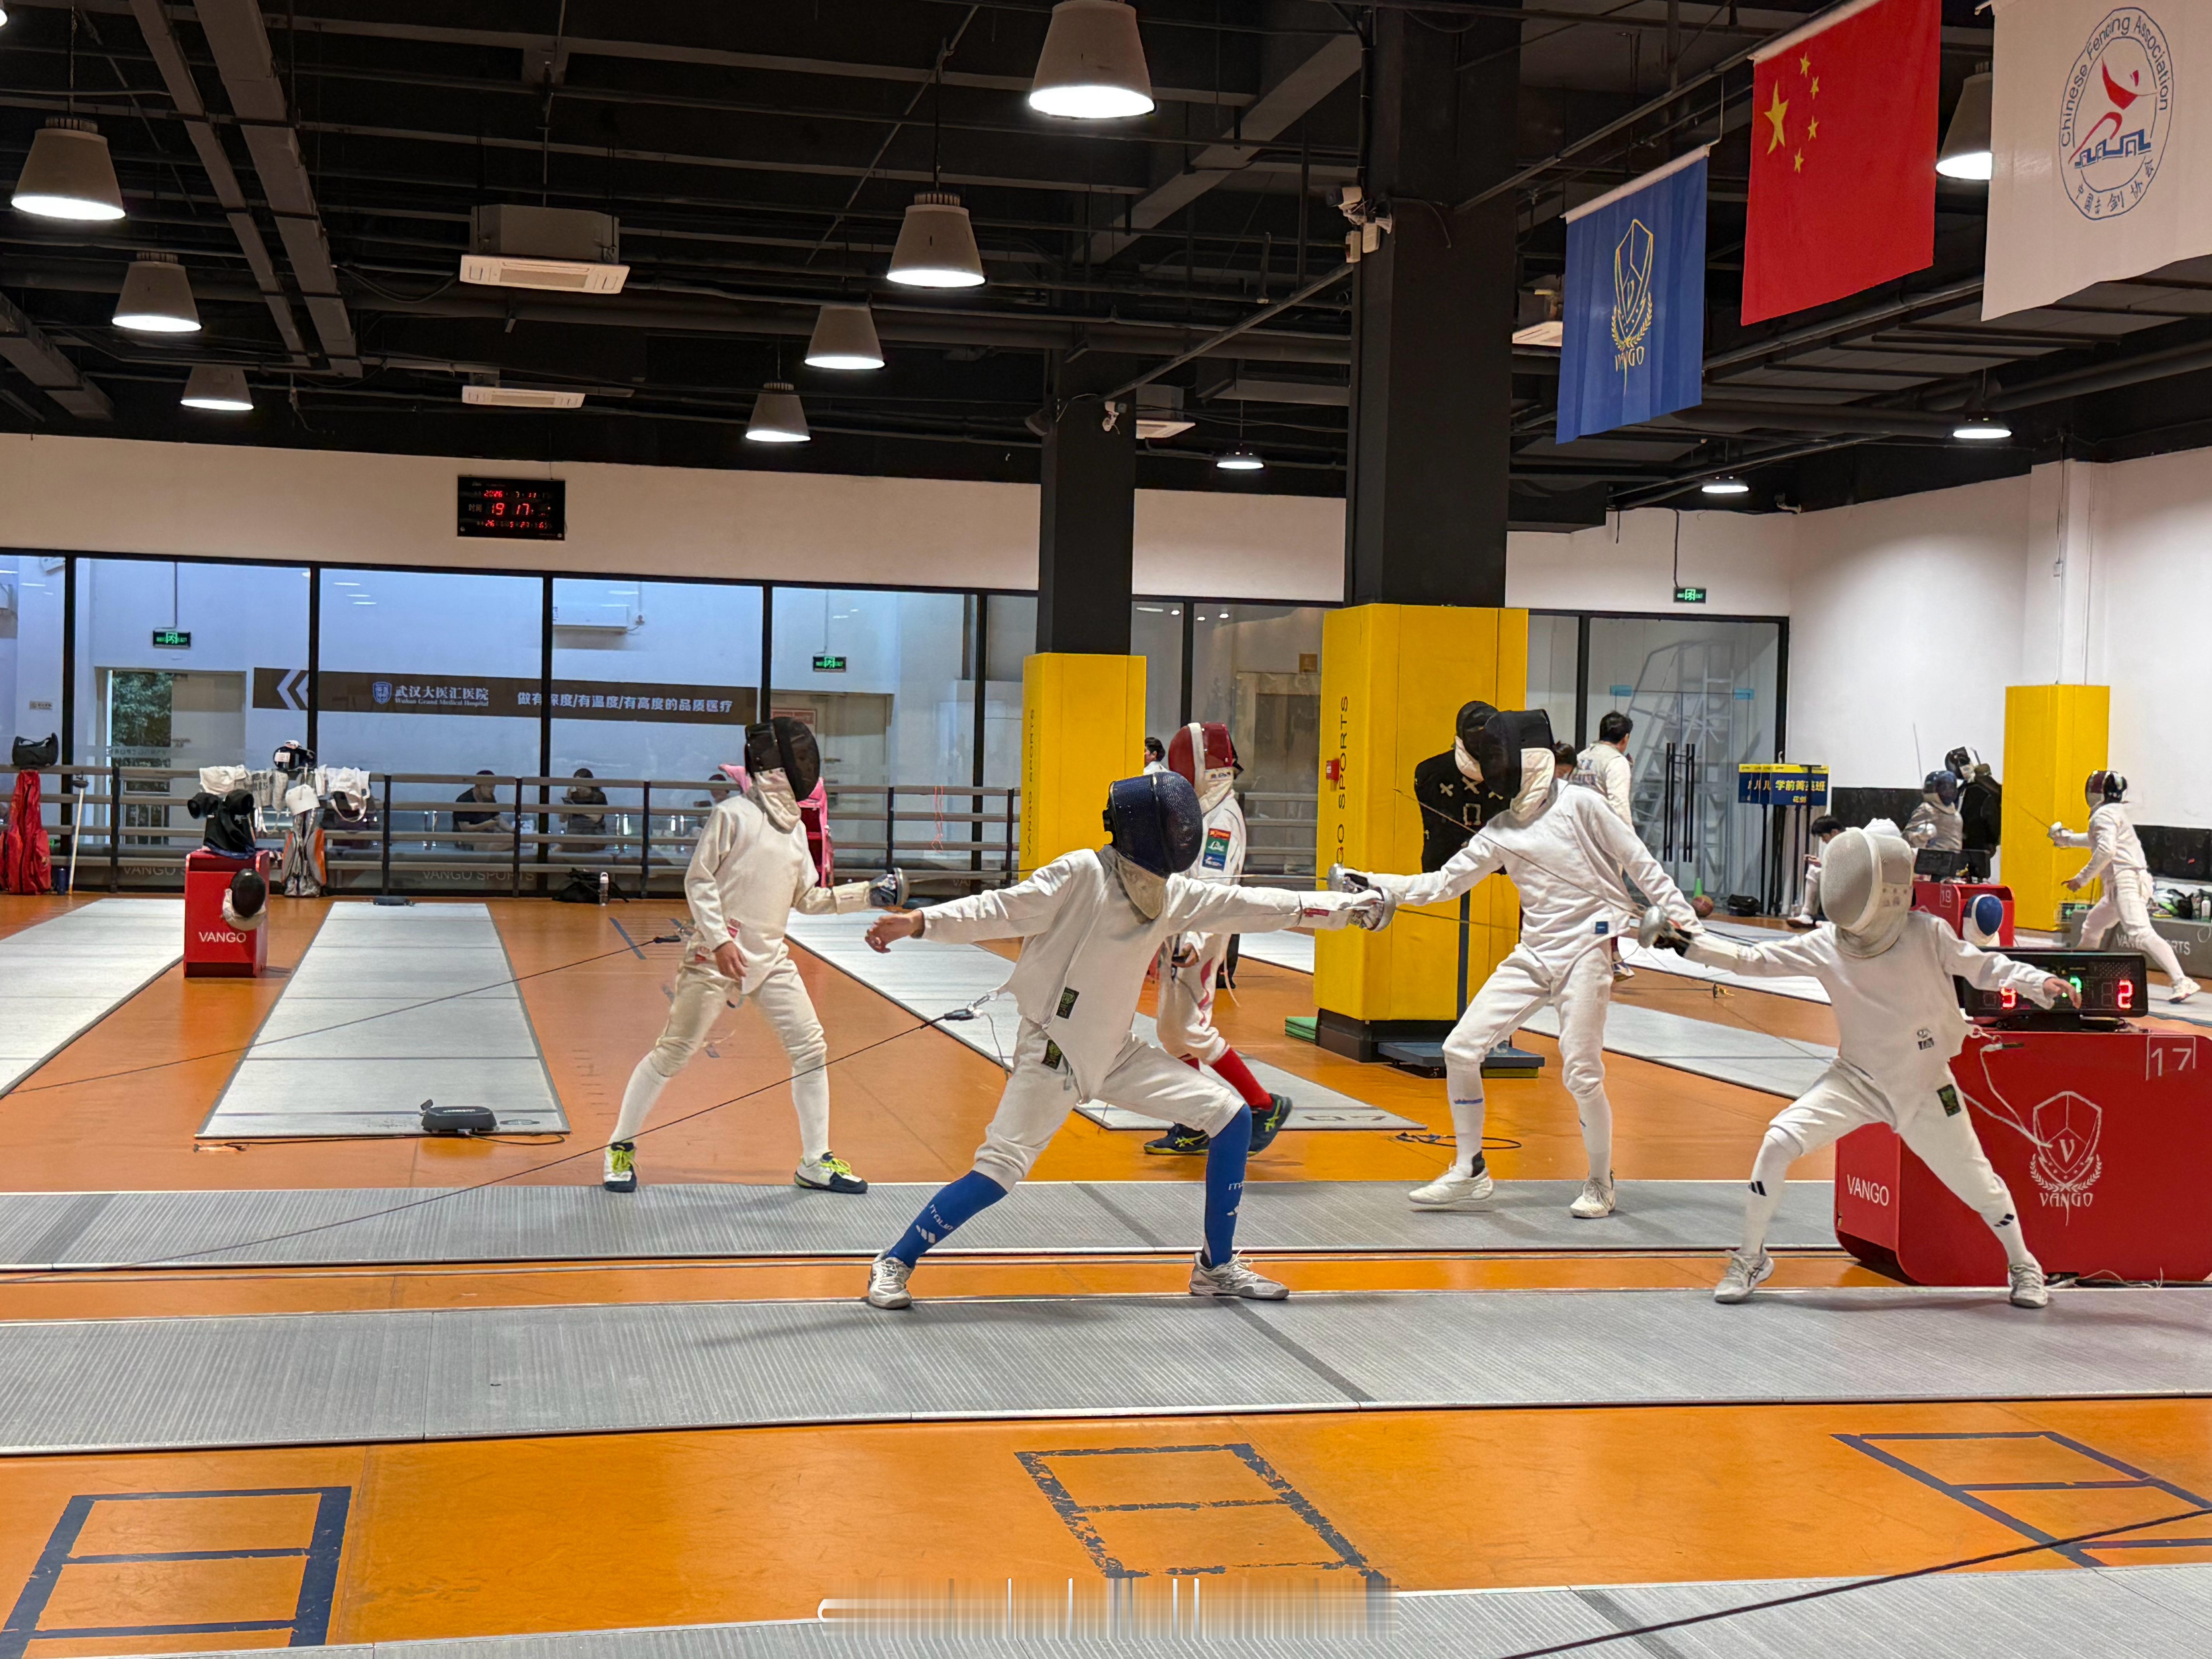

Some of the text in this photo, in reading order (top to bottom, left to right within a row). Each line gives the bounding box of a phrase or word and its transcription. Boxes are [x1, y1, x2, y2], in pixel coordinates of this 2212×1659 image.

[2061, 15, 2170, 147] Chinese Fencing Association
[1338, 696, 1348, 809] SPORTS
[199, 931, 247, 943] VANGO
[2118, 979, 2133, 1009] 2
[2151, 1048, 2191, 1077] 17
[1847, 1174, 1889, 1206] VANGO
